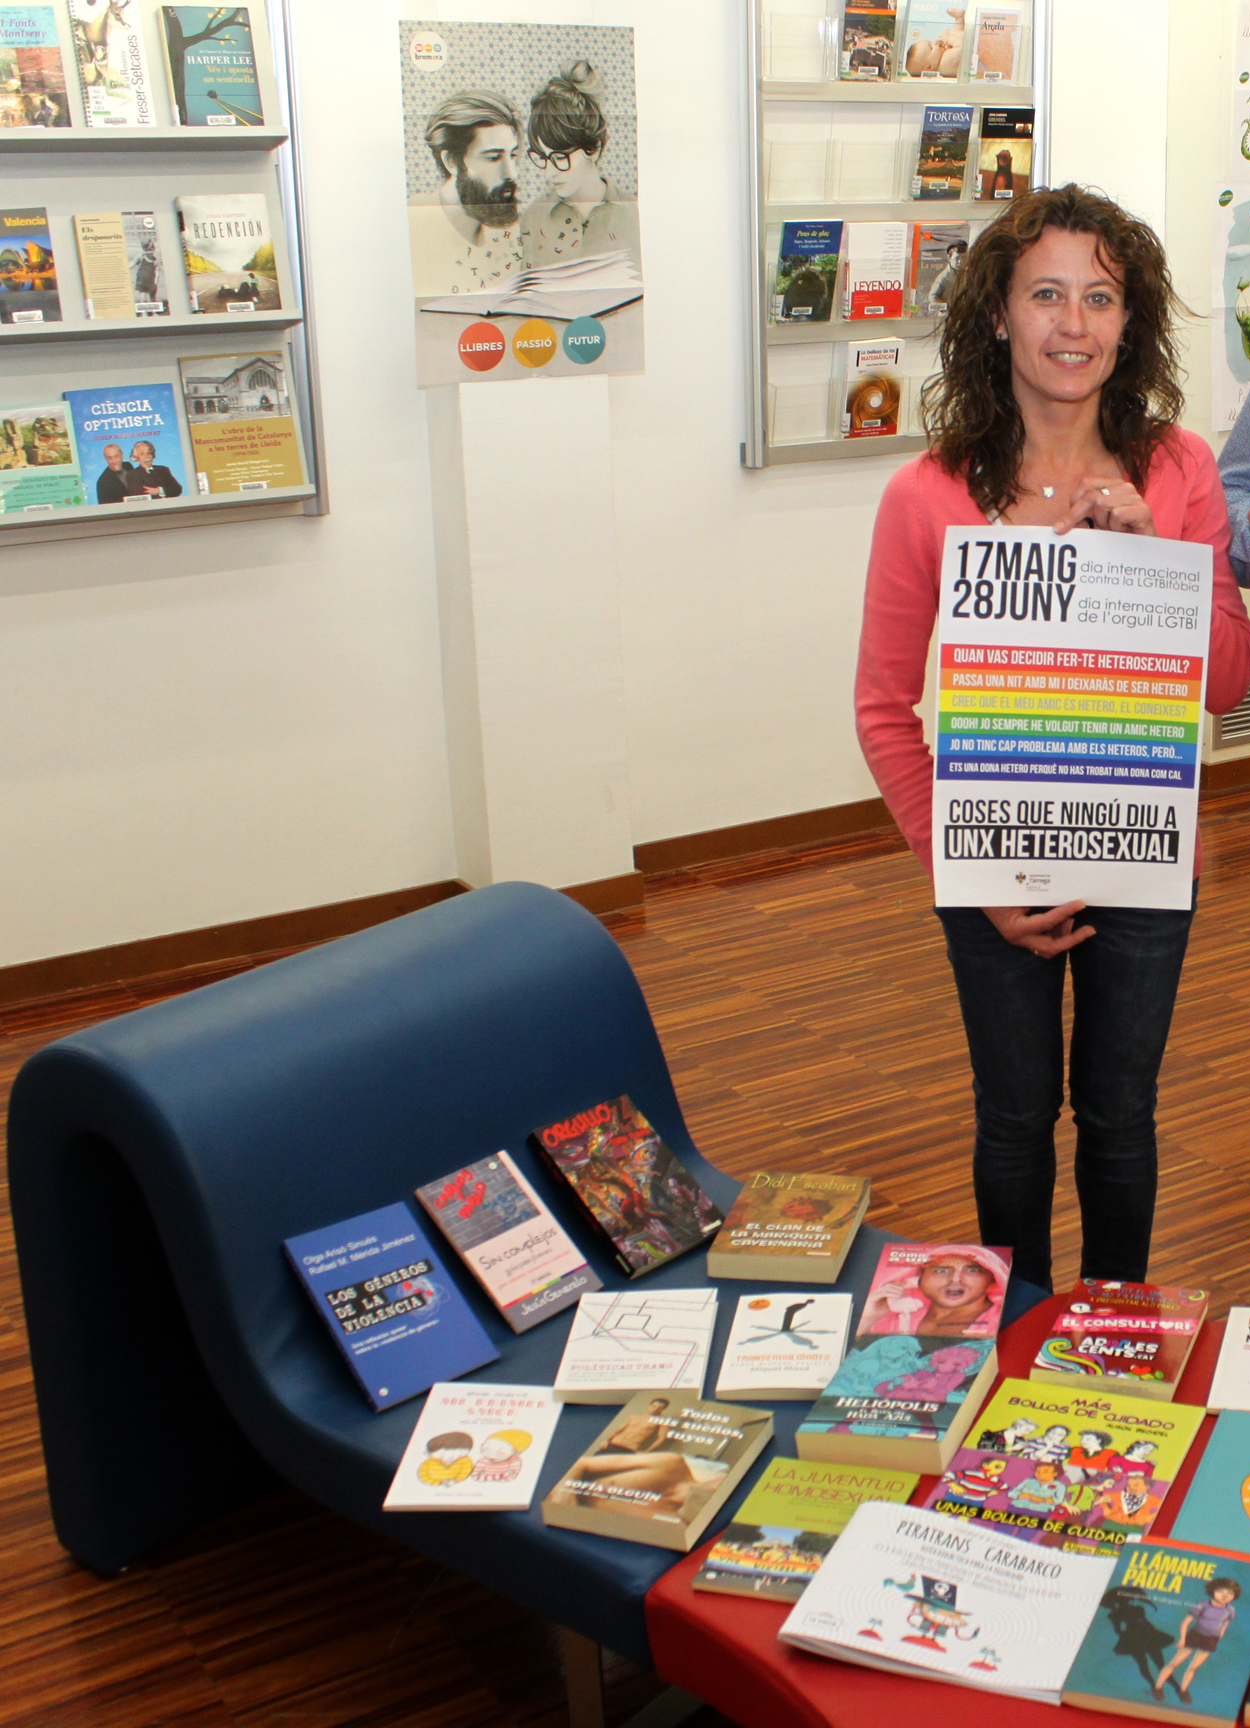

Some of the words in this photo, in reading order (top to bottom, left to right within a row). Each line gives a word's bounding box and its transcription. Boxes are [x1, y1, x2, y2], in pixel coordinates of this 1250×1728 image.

[187, 55, 230, 65] HARPER
[233, 55, 253, 65] LEE
[415, 52, 443, 61] bromera
[928, 111, 970, 122] TORTOSA
[4, 216, 46, 228] Valencia
[194, 220, 263, 239] REDENCIÓN
[854, 280, 901, 292] LEYENDO
[460, 342, 503, 352] LLIBRES
[516, 338, 552, 349] PASSIÓ
[568, 336, 601, 346] FUTUR
[91, 399, 153, 416] CIÈNCIA
[84, 414, 165, 432] OPTIMISTA
[1080, 575, 1118, 585] contra
[1123, 575, 1133, 586] la
[1081, 561, 1103, 574] dia
[1108, 562, 1200, 582] internacional
[1079, 598, 1101, 610] dia
[1106, 599, 1198, 616] internacional
[1078, 610, 1098, 623] de
[1158, 616, 1197, 630] LGTBI
[954, 648, 984, 663] QUAN
[987, 649, 1008, 664] VAS
[1011, 650, 1054, 666] DECIDIR
[1057, 652, 1095, 668] FER-TE
[1098, 654, 1190, 674] HETEROSEXUAL?
[953, 674, 983, 687] PASSA
[985, 675, 1004, 688] UNA
[1007, 676, 1023, 688] NIT
[1025, 676, 1046, 689] AMB
[1049, 678, 1060, 690] MI
[1067, 676, 1115, 693] DEIXARÀS
[1119, 681, 1129, 693] DE
[1131, 681, 1149, 694] SER
[1152, 682, 1188, 696] HETERO
[952, 695, 976, 708] CREC
[979, 696, 998, 709] QUE
[1000, 697, 1012, 709] EL
[1014, 697, 1035, 710] MEU
[1037, 698, 1061, 711] AMIC
[1121, 701, 1131, 713] EL
[1134, 702, 1187, 716] CONEIXES?
[951, 717, 978, 730] OOOH!
[980, 718, 990, 730] JO
[992, 719, 1028, 731] SEMPRE
[1031, 720, 1043, 731] HE
[1045, 720, 1079, 733] VOLGUT
[1082, 722, 1107, 734] TENIR
[1110, 722, 1122, 734] UN
[1124, 723, 1147, 735] AMIC
[1150, 725, 1184, 738] HETERO
[950, 739, 960, 750] JO
[962, 739, 974, 751] NO
[976, 740, 996, 751] TINC
[998, 740, 1016, 752] CAP
[1018, 740, 1066, 754] PROBLEMA
[1067, 742, 1087, 754] AMB
[1089, 743, 1105, 755] ELS
[1108, 744, 1150, 758] HETEROS,
[949, 763, 962, 772] ETS
[964, 763, 978, 772] UNA
[980, 763, 999, 773] DONA
[1001, 764, 1028, 774] HETERO
[1030, 763, 1057, 775] PERQUÈ
[1059, 765, 1068, 775] NO
[1070, 766, 1084, 775] HAS
[1086, 766, 1112, 777] TROBAT
[1114, 767, 1128, 777] UNA
[1130, 768, 1149, 778] DONA
[1151, 769, 1167, 779] COM
[1169, 770, 1182, 780] CAL
[949, 799, 1010, 824] COSES
[1017, 801, 1054, 826] QUE
[1061, 798, 1119, 827] NINGÚ
[1127, 804, 1158, 828] DIU
[1164, 806, 1176, 829] A
[948, 828, 994, 858] UNX
[1001, 829, 1175, 861] HETEROSEXUAL
[326, 1288, 357, 1306] LOS
[364, 1261, 429, 1293] GÉNEROS
[335, 1304, 357, 1320] DE
[362, 1295, 384, 1310] LA
[342, 1296, 424, 1335] VIOLENCIA
[1008, 1397, 1070, 1414] BOLLOS
[1074, 1408, 1098, 1419] DE
[1104, 1412, 1175, 1430] CUIDADO
[1071, 1399, 1112, 1411] MÁS
[648, 1415, 679, 1427] mis
[681, 1407, 731, 1423] Todos
[666, 1429, 715, 1445] tuyos
[773, 1468, 796, 1479] LA
[800, 1470, 906, 1492] JUVENTUD
[896, 1520, 970, 1555] PIRATRANS
[984, 1546, 1062, 1579] CARABARCO
[1129, 1551, 1217, 1581] LLÁMAME
[1122, 1568, 1183, 1594] PAULA
